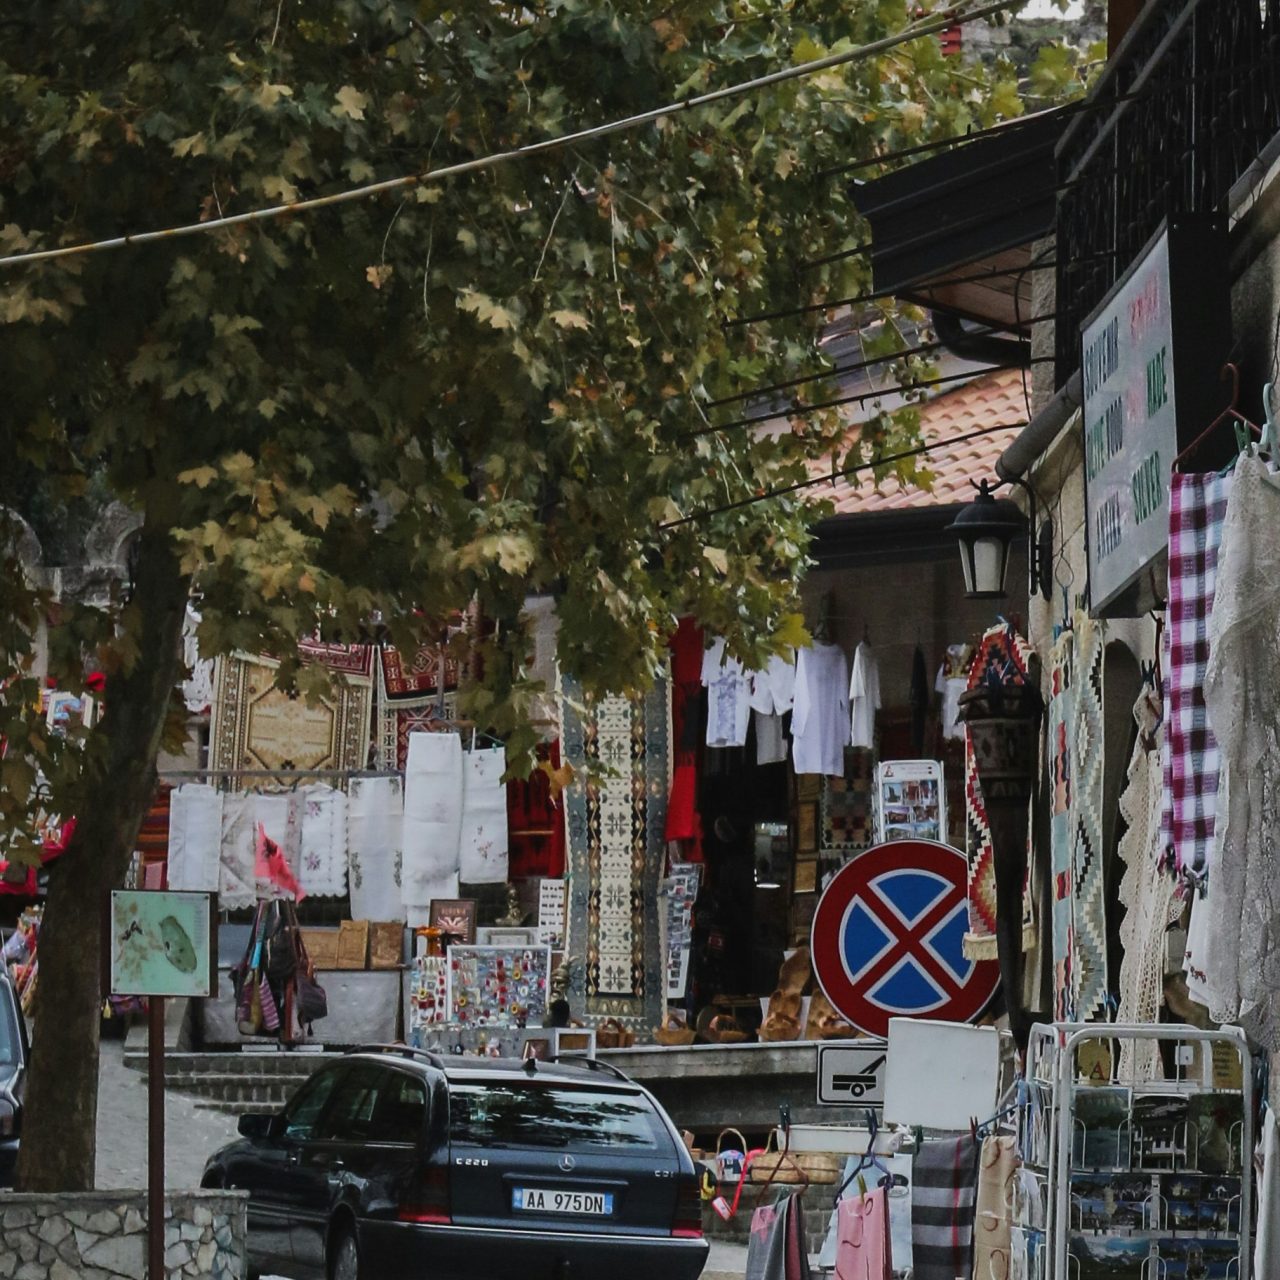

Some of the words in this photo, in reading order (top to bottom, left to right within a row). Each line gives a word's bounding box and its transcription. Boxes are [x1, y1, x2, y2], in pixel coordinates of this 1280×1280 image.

[1085, 314, 1119, 401] SOUVENIR
[1146, 345, 1167, 419] MADE
[1132, 450, 1162, 526] SILVER
[527, 1191, 545, 1209] AA
